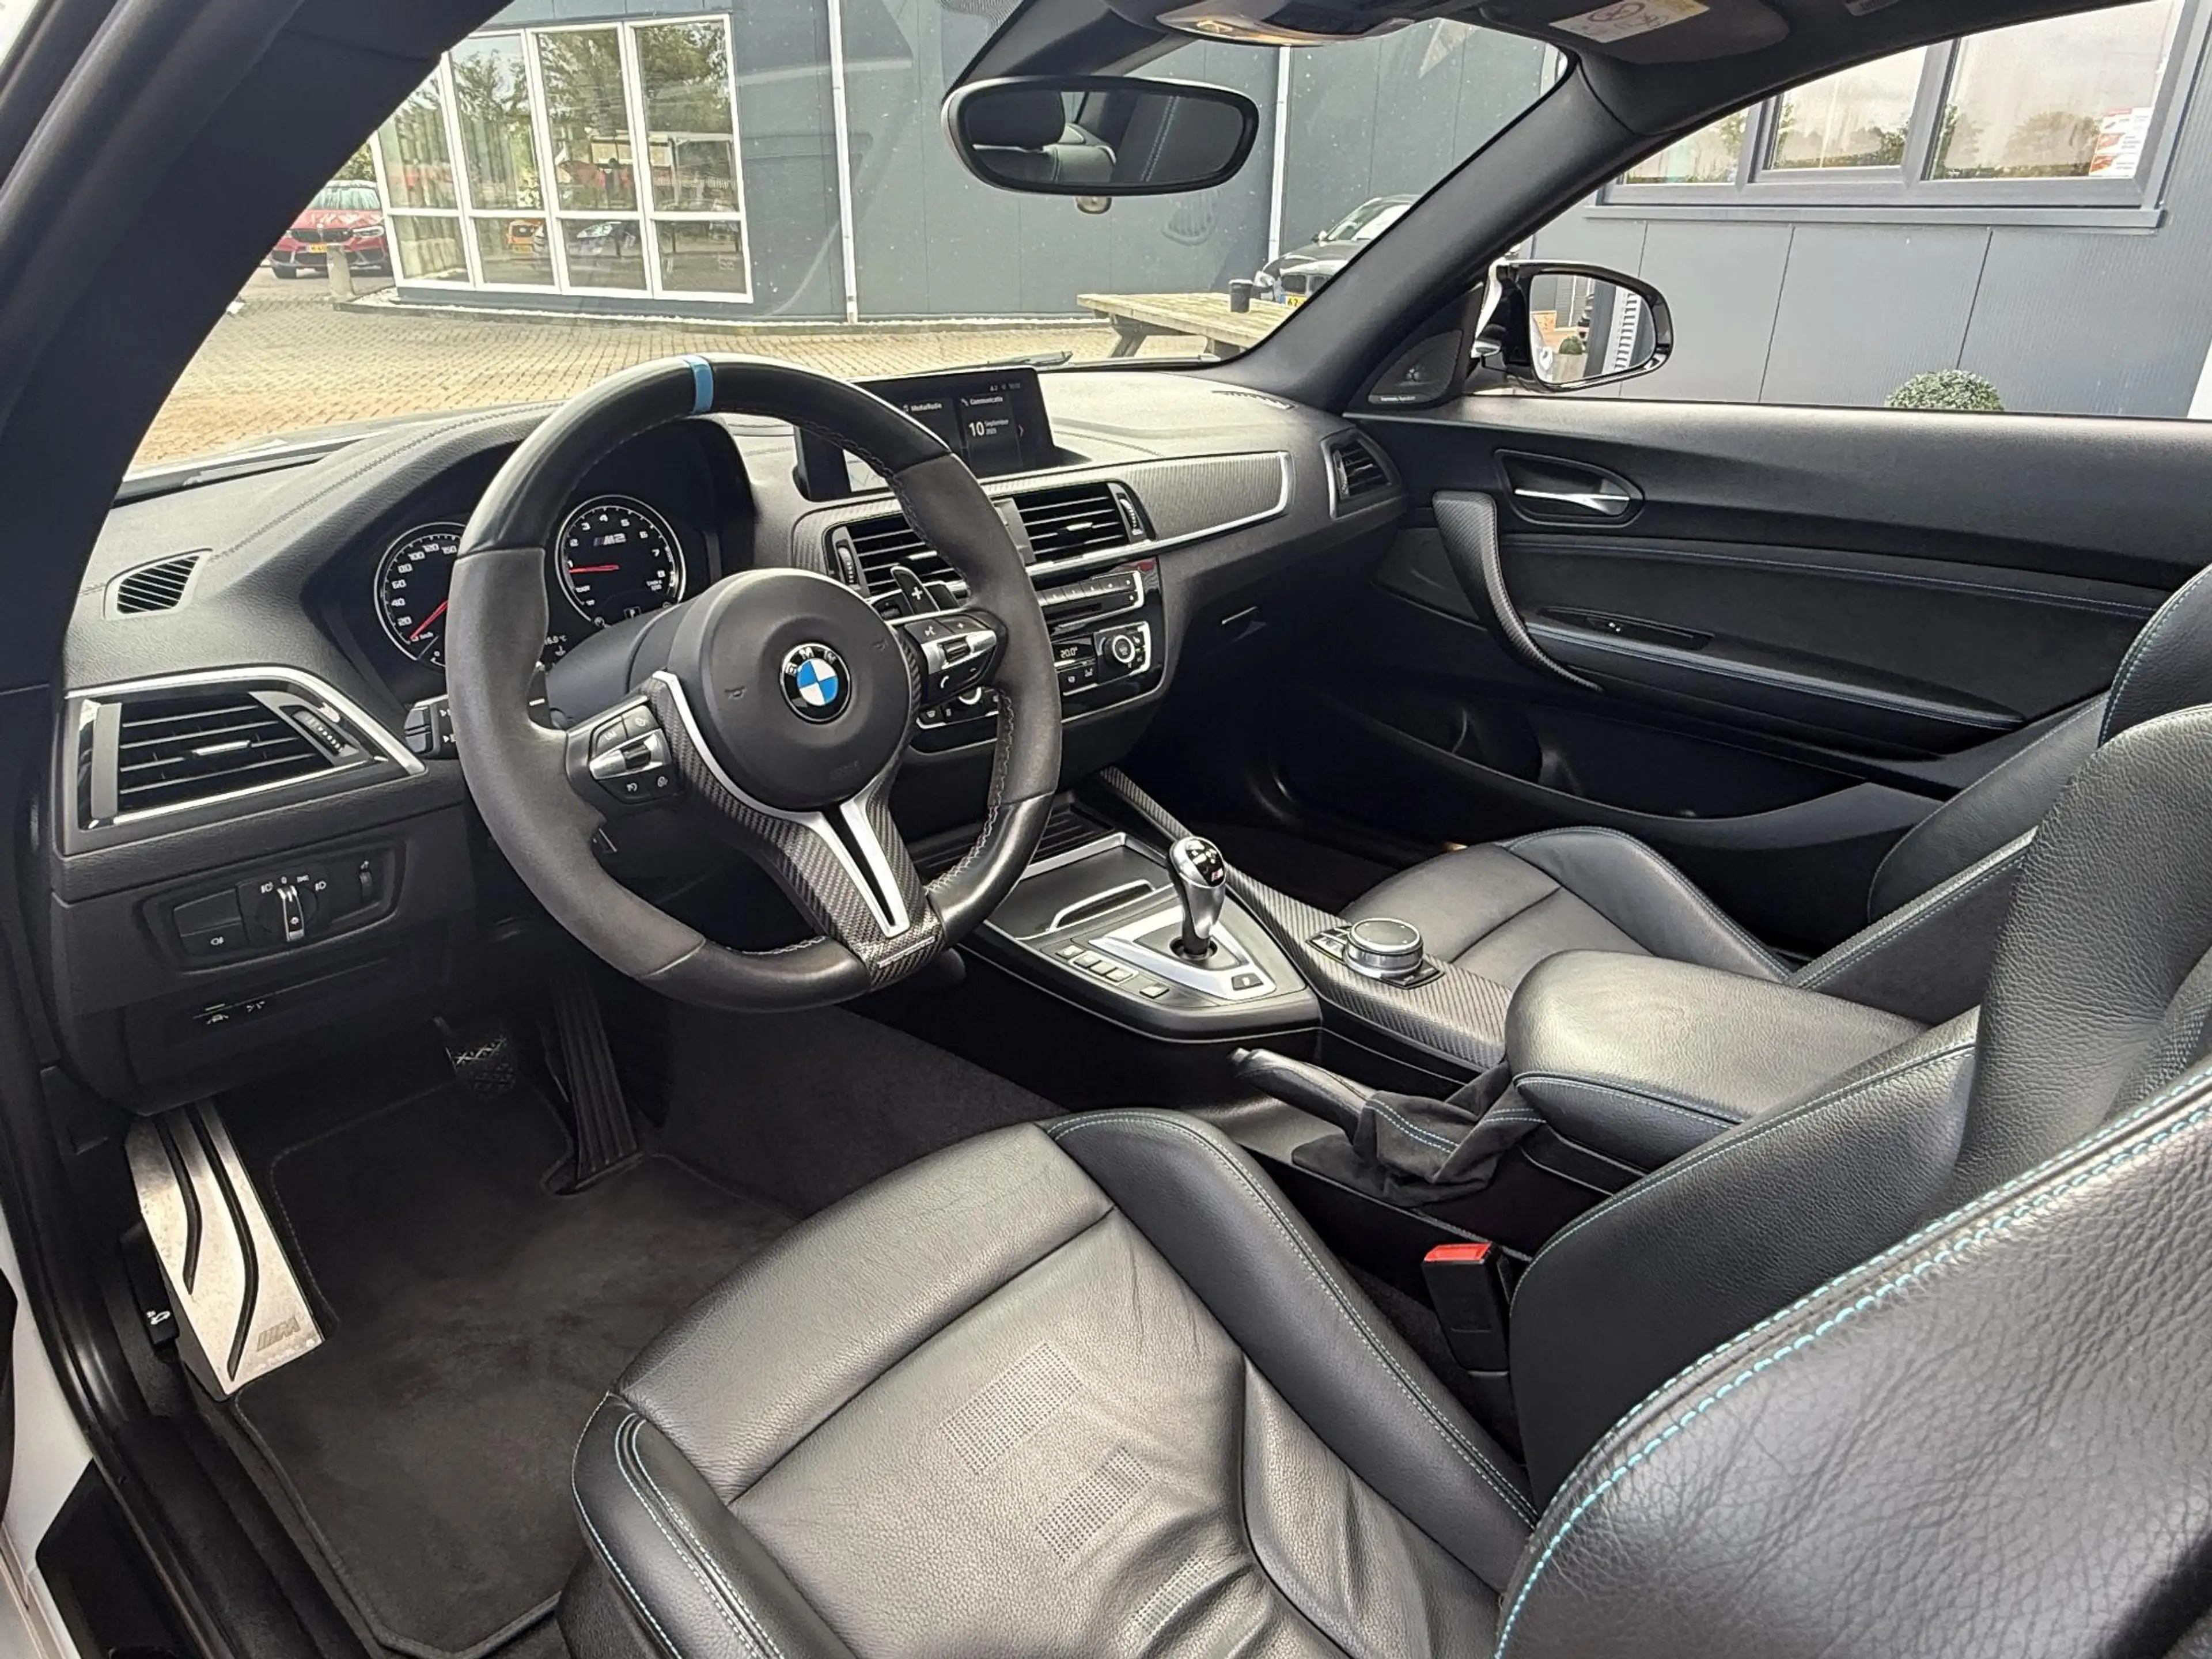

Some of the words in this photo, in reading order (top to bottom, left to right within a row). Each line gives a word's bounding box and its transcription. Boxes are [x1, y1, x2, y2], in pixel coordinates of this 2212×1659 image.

[969, 421, 985, 437] 10
[581, 522, 591, 531] 3
[620, 519, 630, 527] 5
[422, 543, 440, 553] 120
[652, 548, 660, 557] 7
[408, 551, 426, 561] 100
[391, 579, 407, 589] 60
[391, 598, 406, 607] 40
[396, 616, 412, 626] 20
[785, 646, 837, 677] BMW
